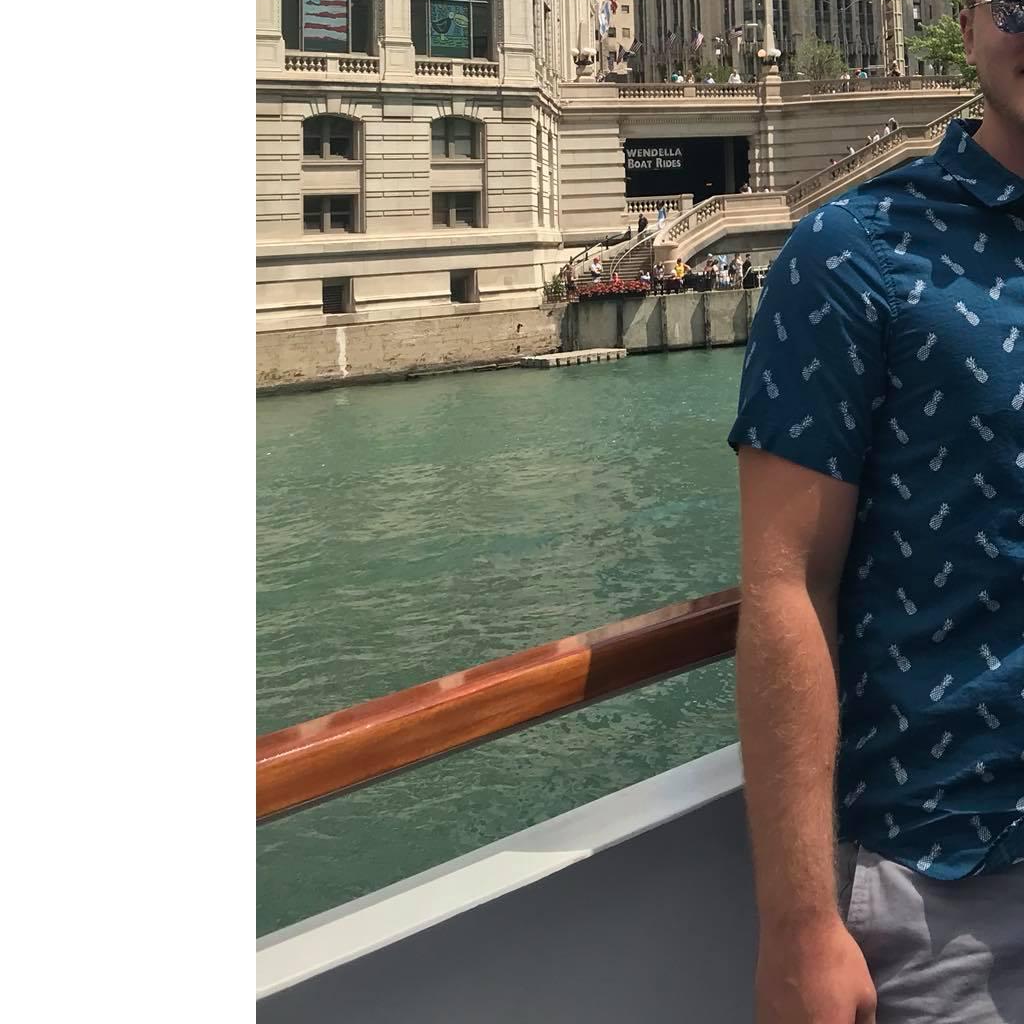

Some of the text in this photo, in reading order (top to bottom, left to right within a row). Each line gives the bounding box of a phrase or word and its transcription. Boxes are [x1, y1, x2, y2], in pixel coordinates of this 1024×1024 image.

[626, 148, 682, 157] WENDELLA
[628, 158, 681, 168] BOAT RIDES
